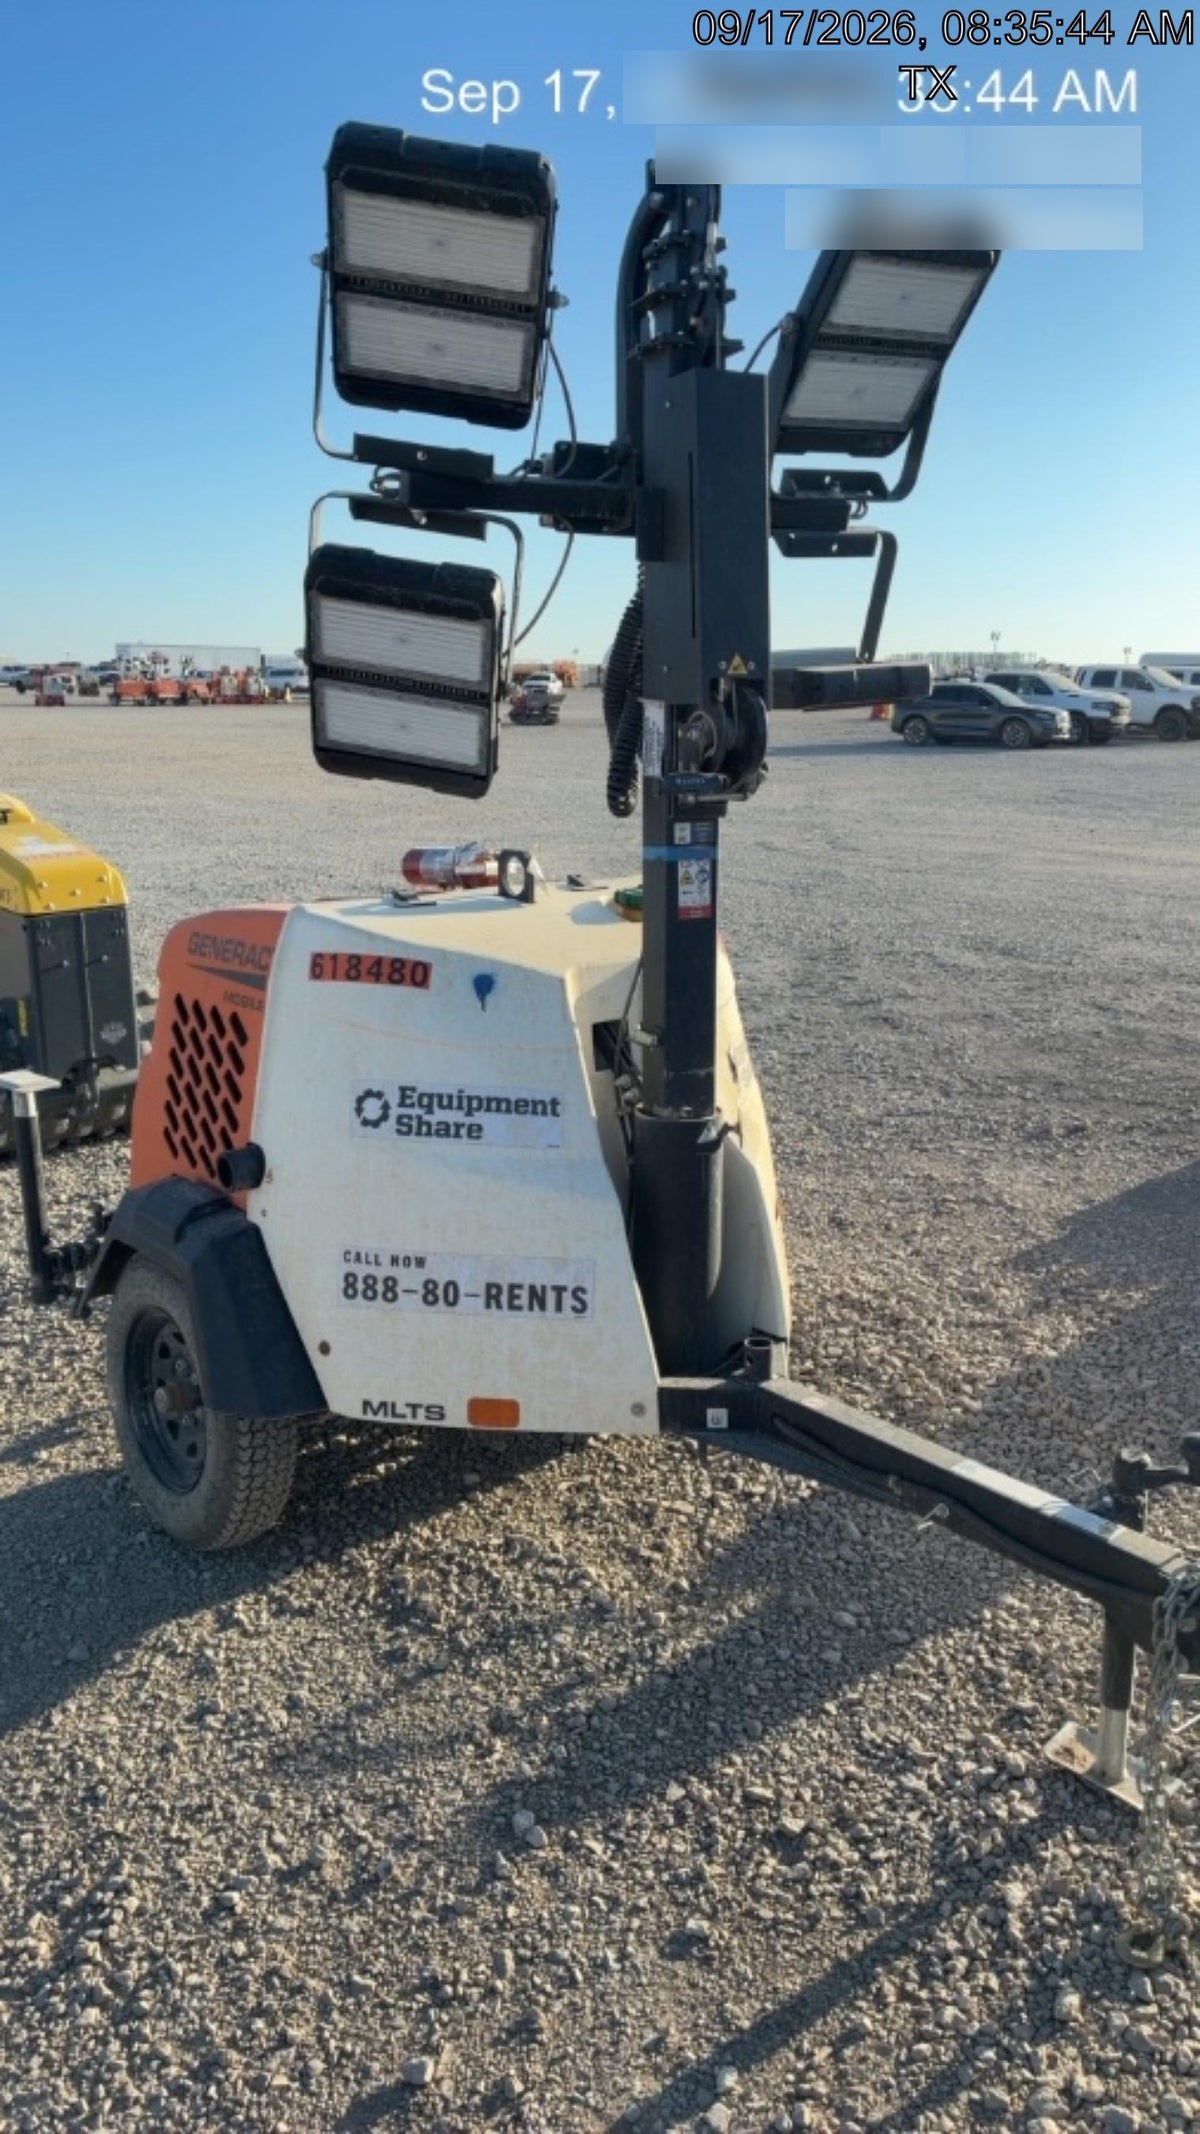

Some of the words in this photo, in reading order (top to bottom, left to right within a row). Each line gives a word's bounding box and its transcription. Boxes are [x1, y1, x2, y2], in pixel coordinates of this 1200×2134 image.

[308, 952, 430, 987] 618480
[397, 1084, 561, 1118] Equipment
[395, 1113, 484, 1140] Share
[343, 1250, 382, 1267] CALL
[343, 1272, 588, 1315] 888-80-RENTS
[361, 1398, 446, 1421] MLTS
